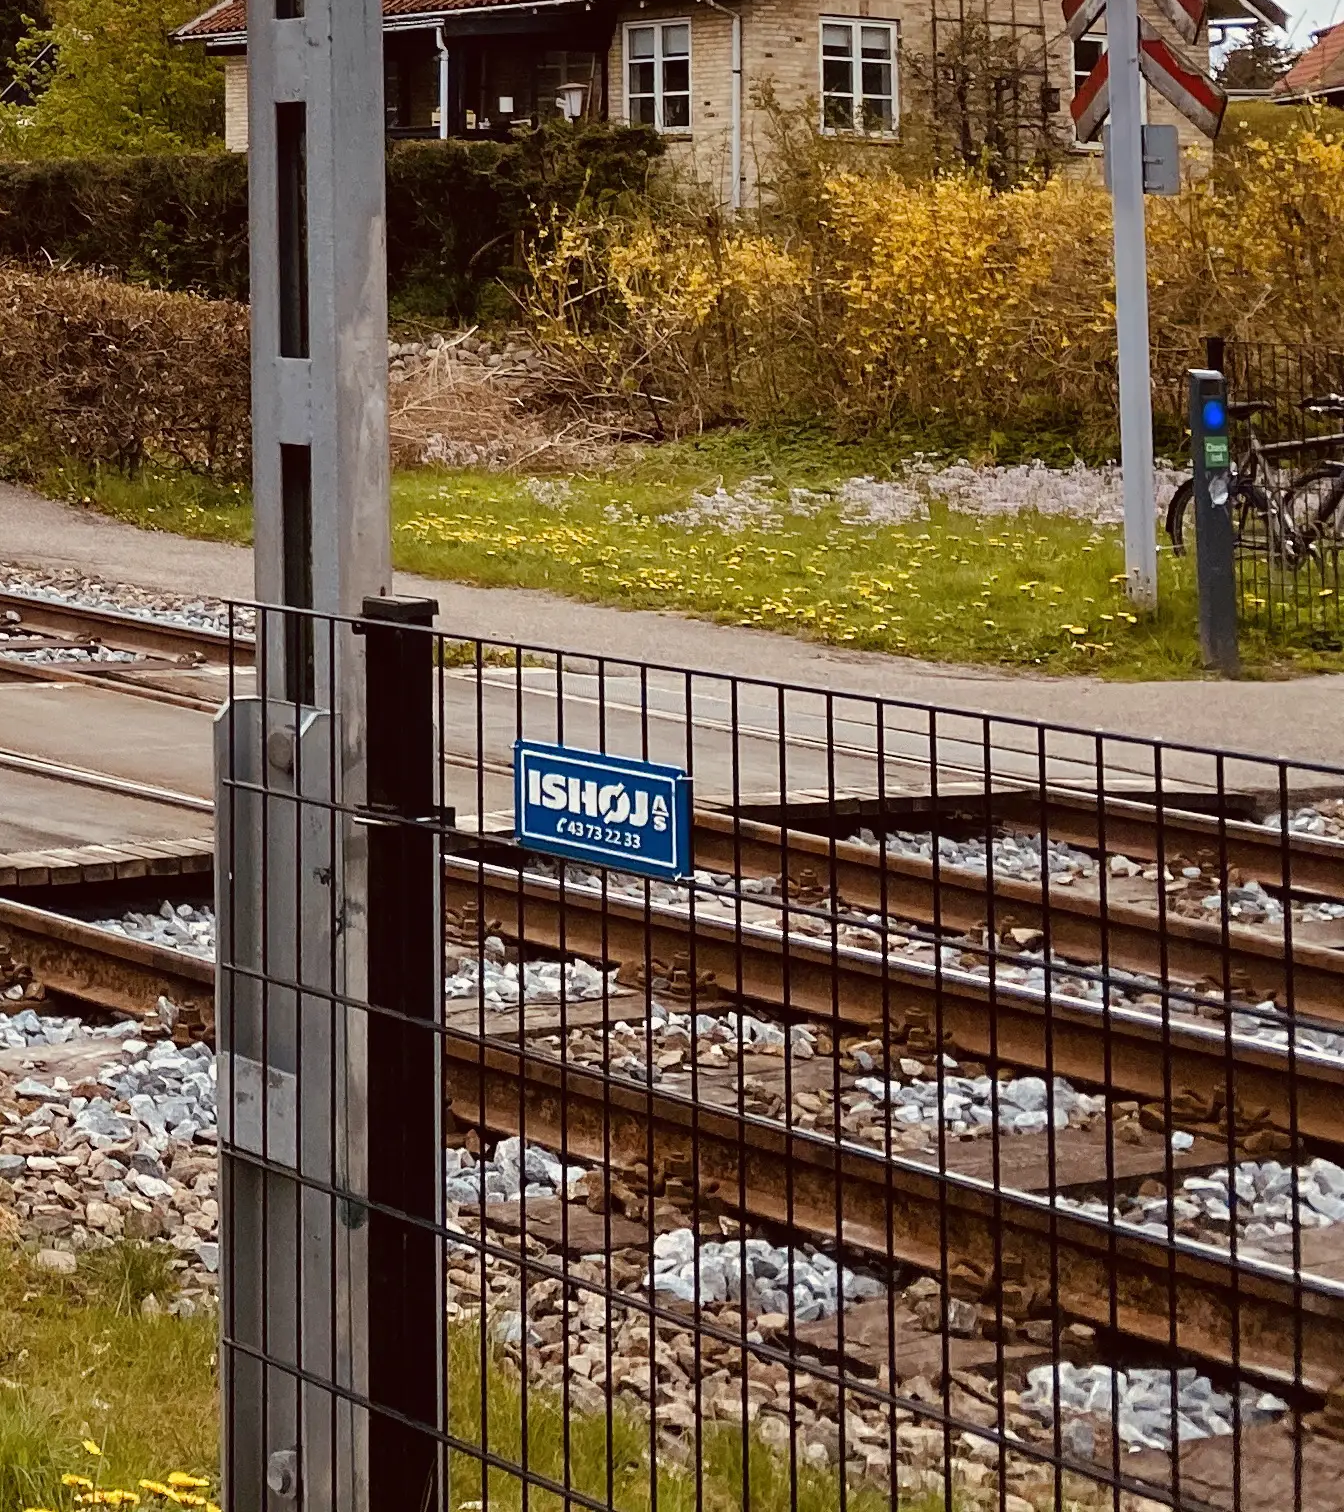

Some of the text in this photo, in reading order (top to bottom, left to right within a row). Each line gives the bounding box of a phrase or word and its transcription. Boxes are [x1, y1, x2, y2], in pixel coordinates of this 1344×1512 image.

[528, 769, 649, 828] ISHØJ
[567, 821, 641, 849] 43 73 22 33
